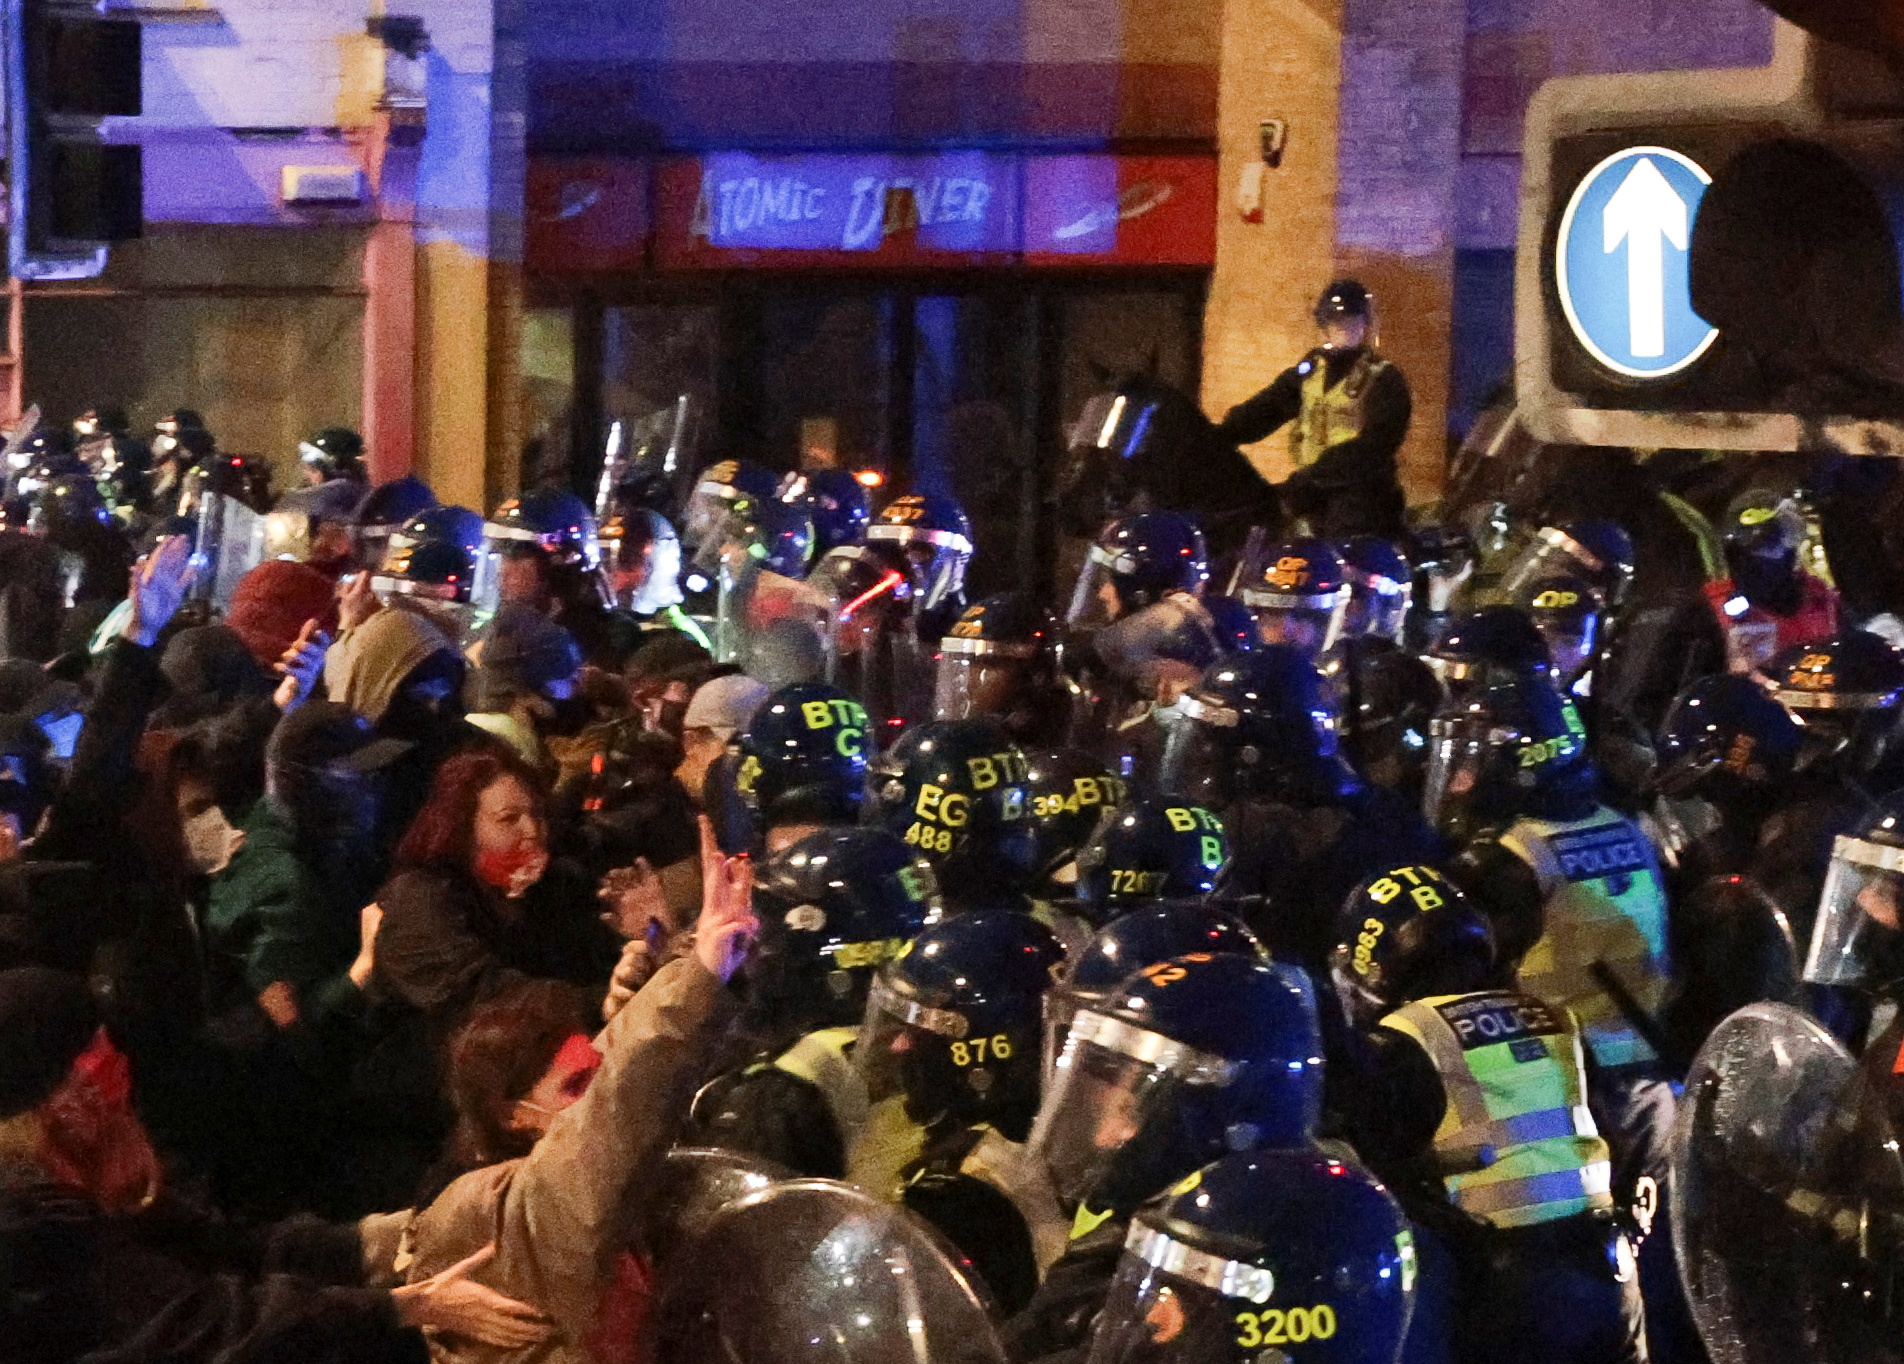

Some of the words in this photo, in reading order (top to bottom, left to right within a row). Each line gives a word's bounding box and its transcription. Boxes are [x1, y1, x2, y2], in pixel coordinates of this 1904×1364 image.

[689, 169, 826, 249] ATOMIC
[836, 728, 864, 757] C
[904, 821, 955, 854] 488
[1201, 835, 1225, 868] B
[1410, 885, 1445, 912] B
[1453, 1006, 1554, 1042] POLICE
[950, 1033, 1012, 1067] 876
[1235, 1304, 1337, 1348] 3200
